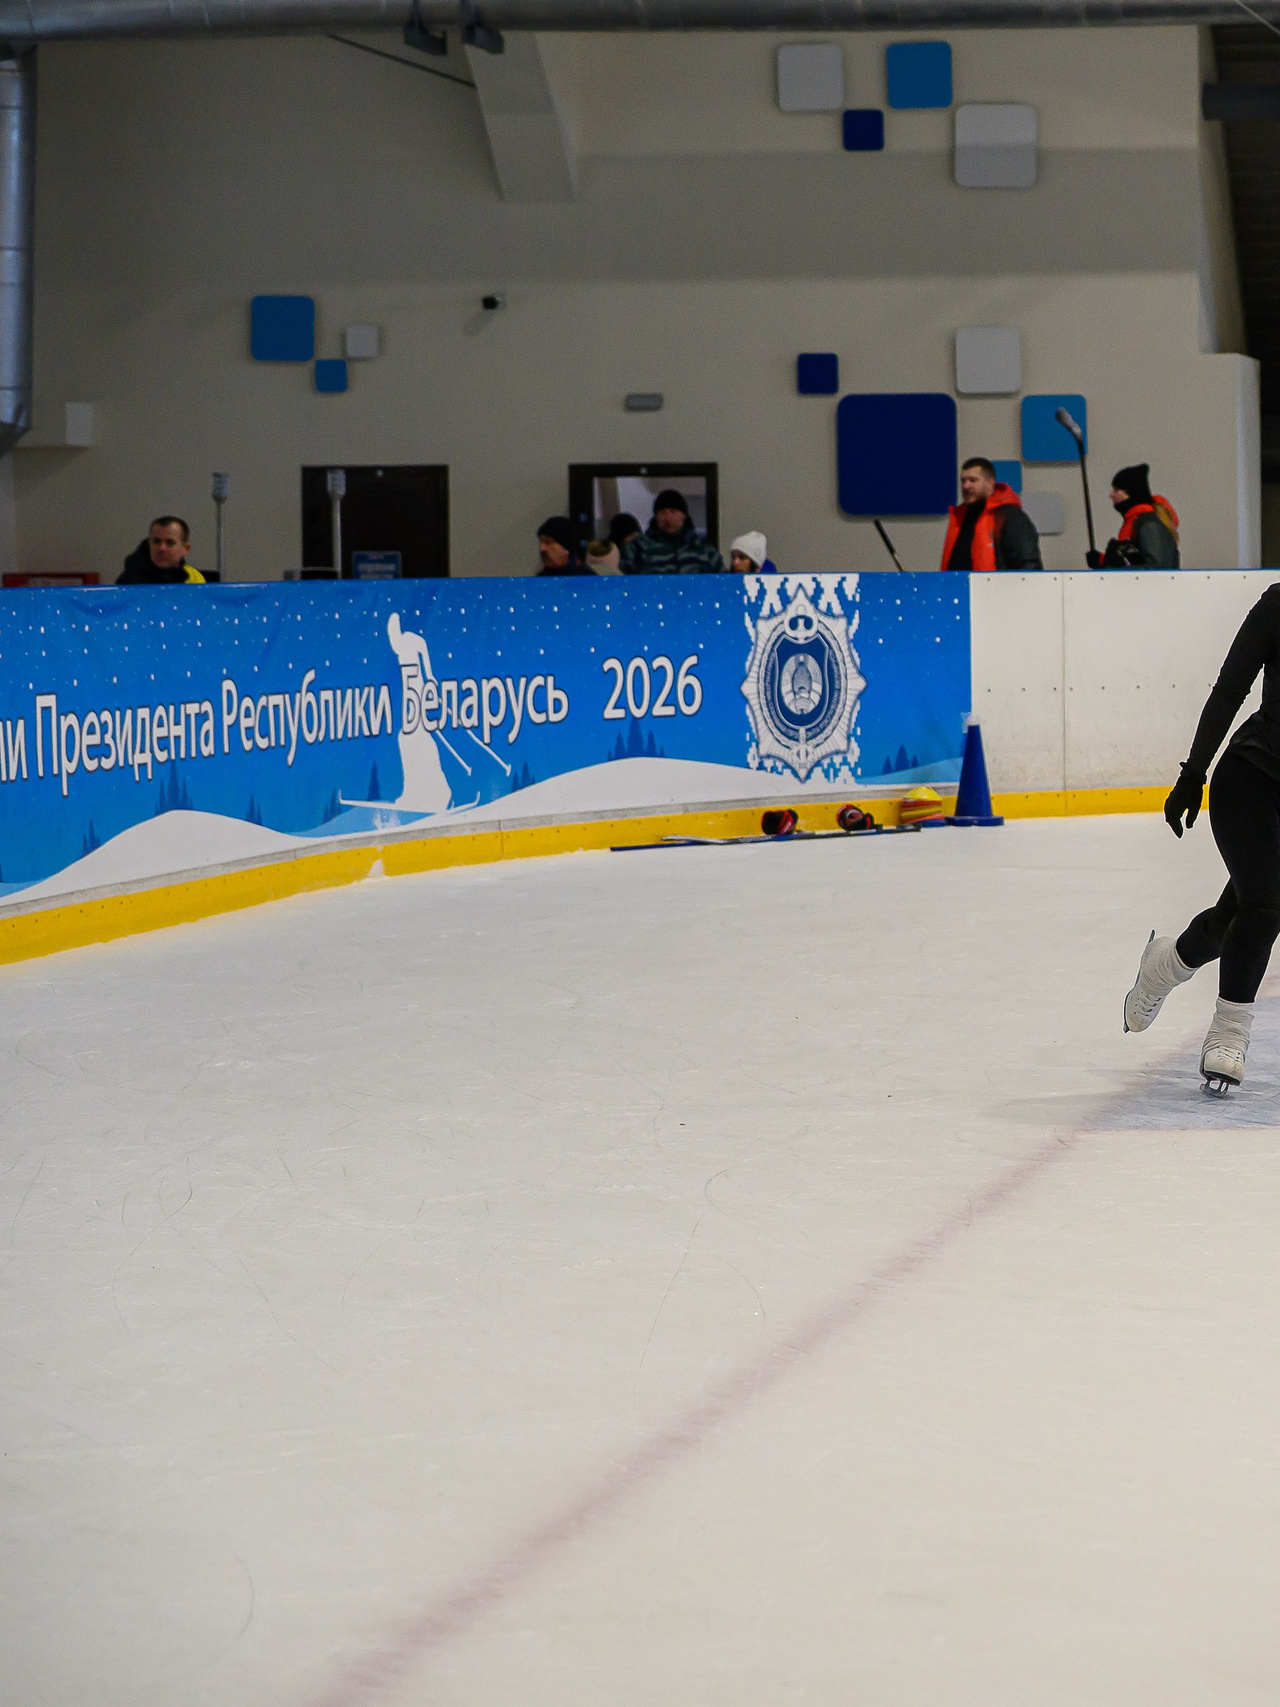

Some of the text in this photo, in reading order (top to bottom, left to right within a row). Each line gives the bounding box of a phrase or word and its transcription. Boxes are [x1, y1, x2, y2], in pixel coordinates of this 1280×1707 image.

[36, 693, 215, 797] Президента
[221, 668, 392, 767] Республики
[400, 664, 569, 744] Беларусь
[602, 654, 703, 720] 2026
